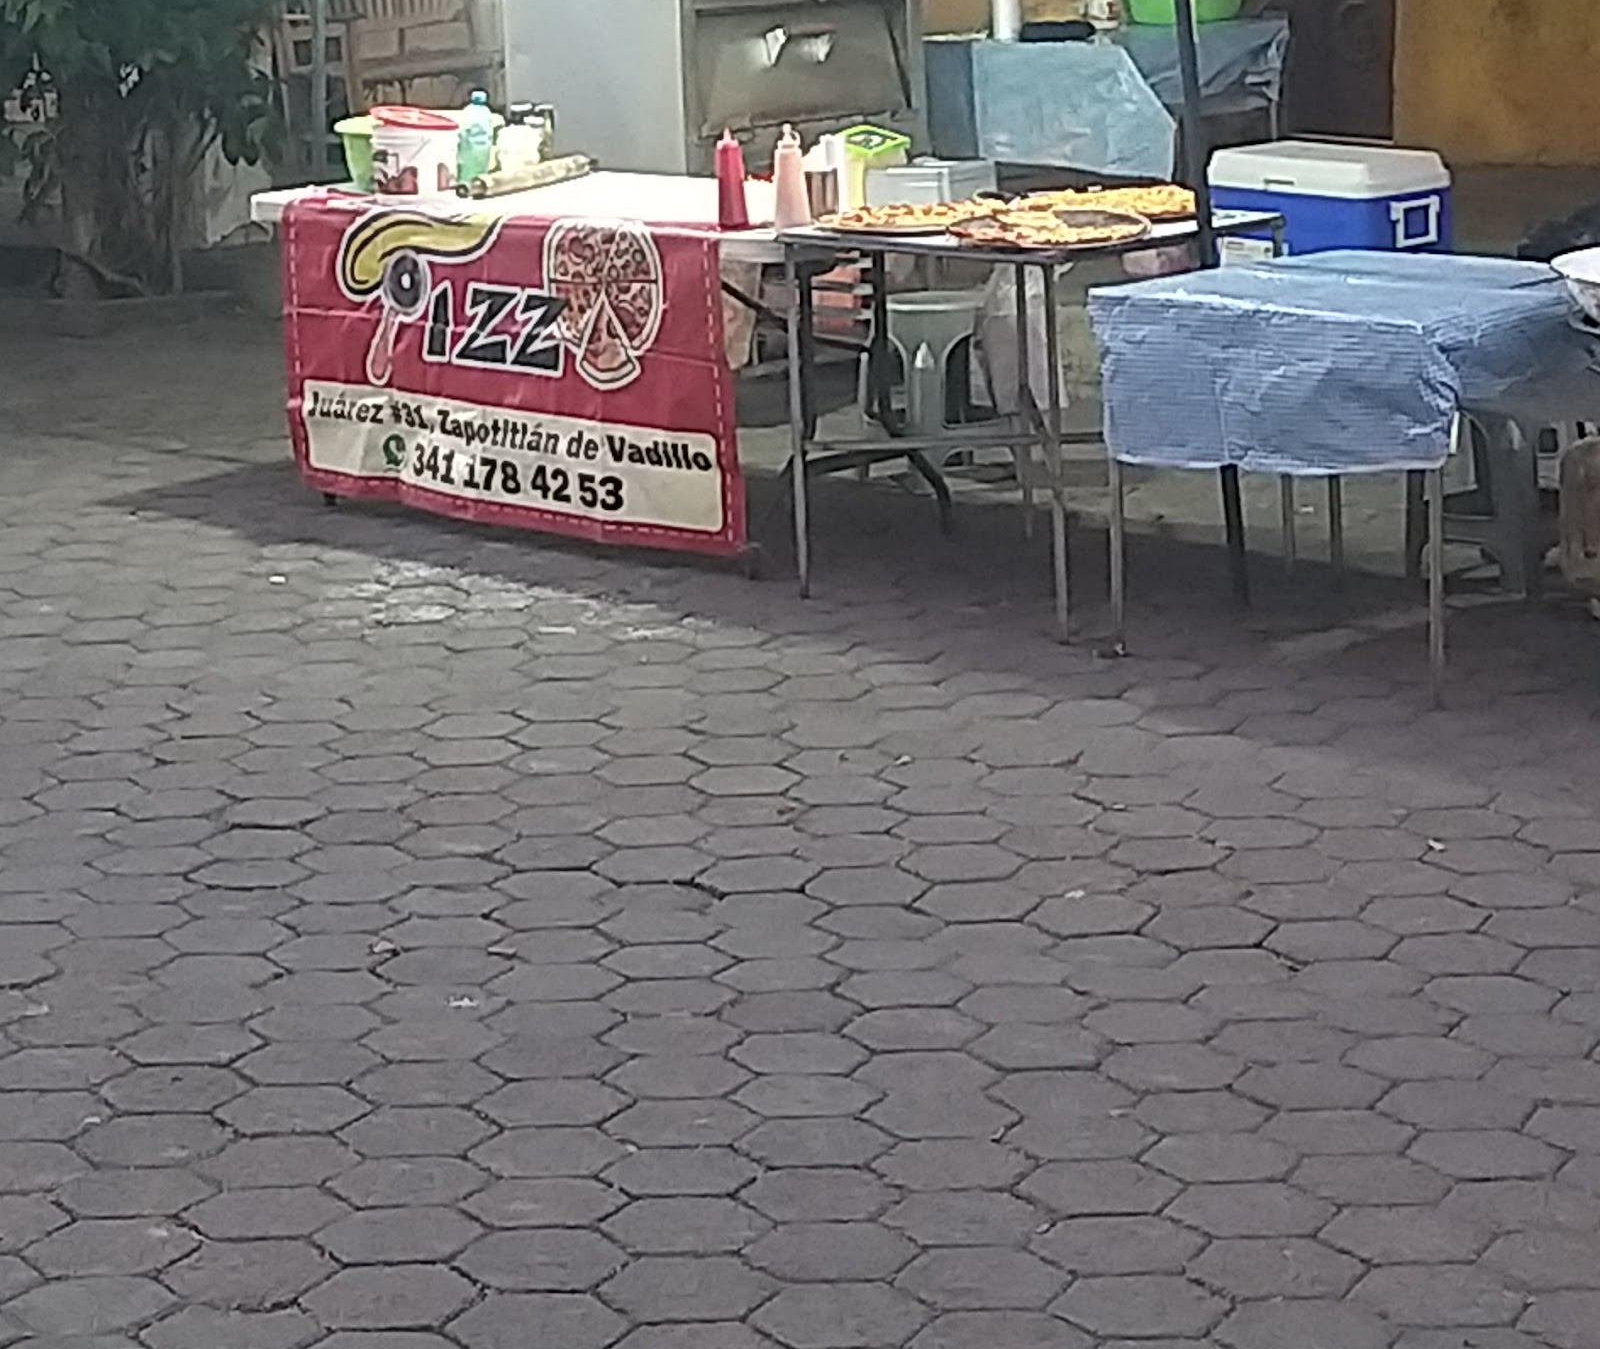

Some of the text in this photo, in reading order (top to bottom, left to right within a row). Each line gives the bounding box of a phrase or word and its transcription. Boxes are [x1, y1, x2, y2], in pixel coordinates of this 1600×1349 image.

[307, 391, 384, 425] Juárez
[565, 429, 600, 461] de
[605, 433, 713, 472] Vadillo
[412, 441, 626, 512] 341 178 42 53
